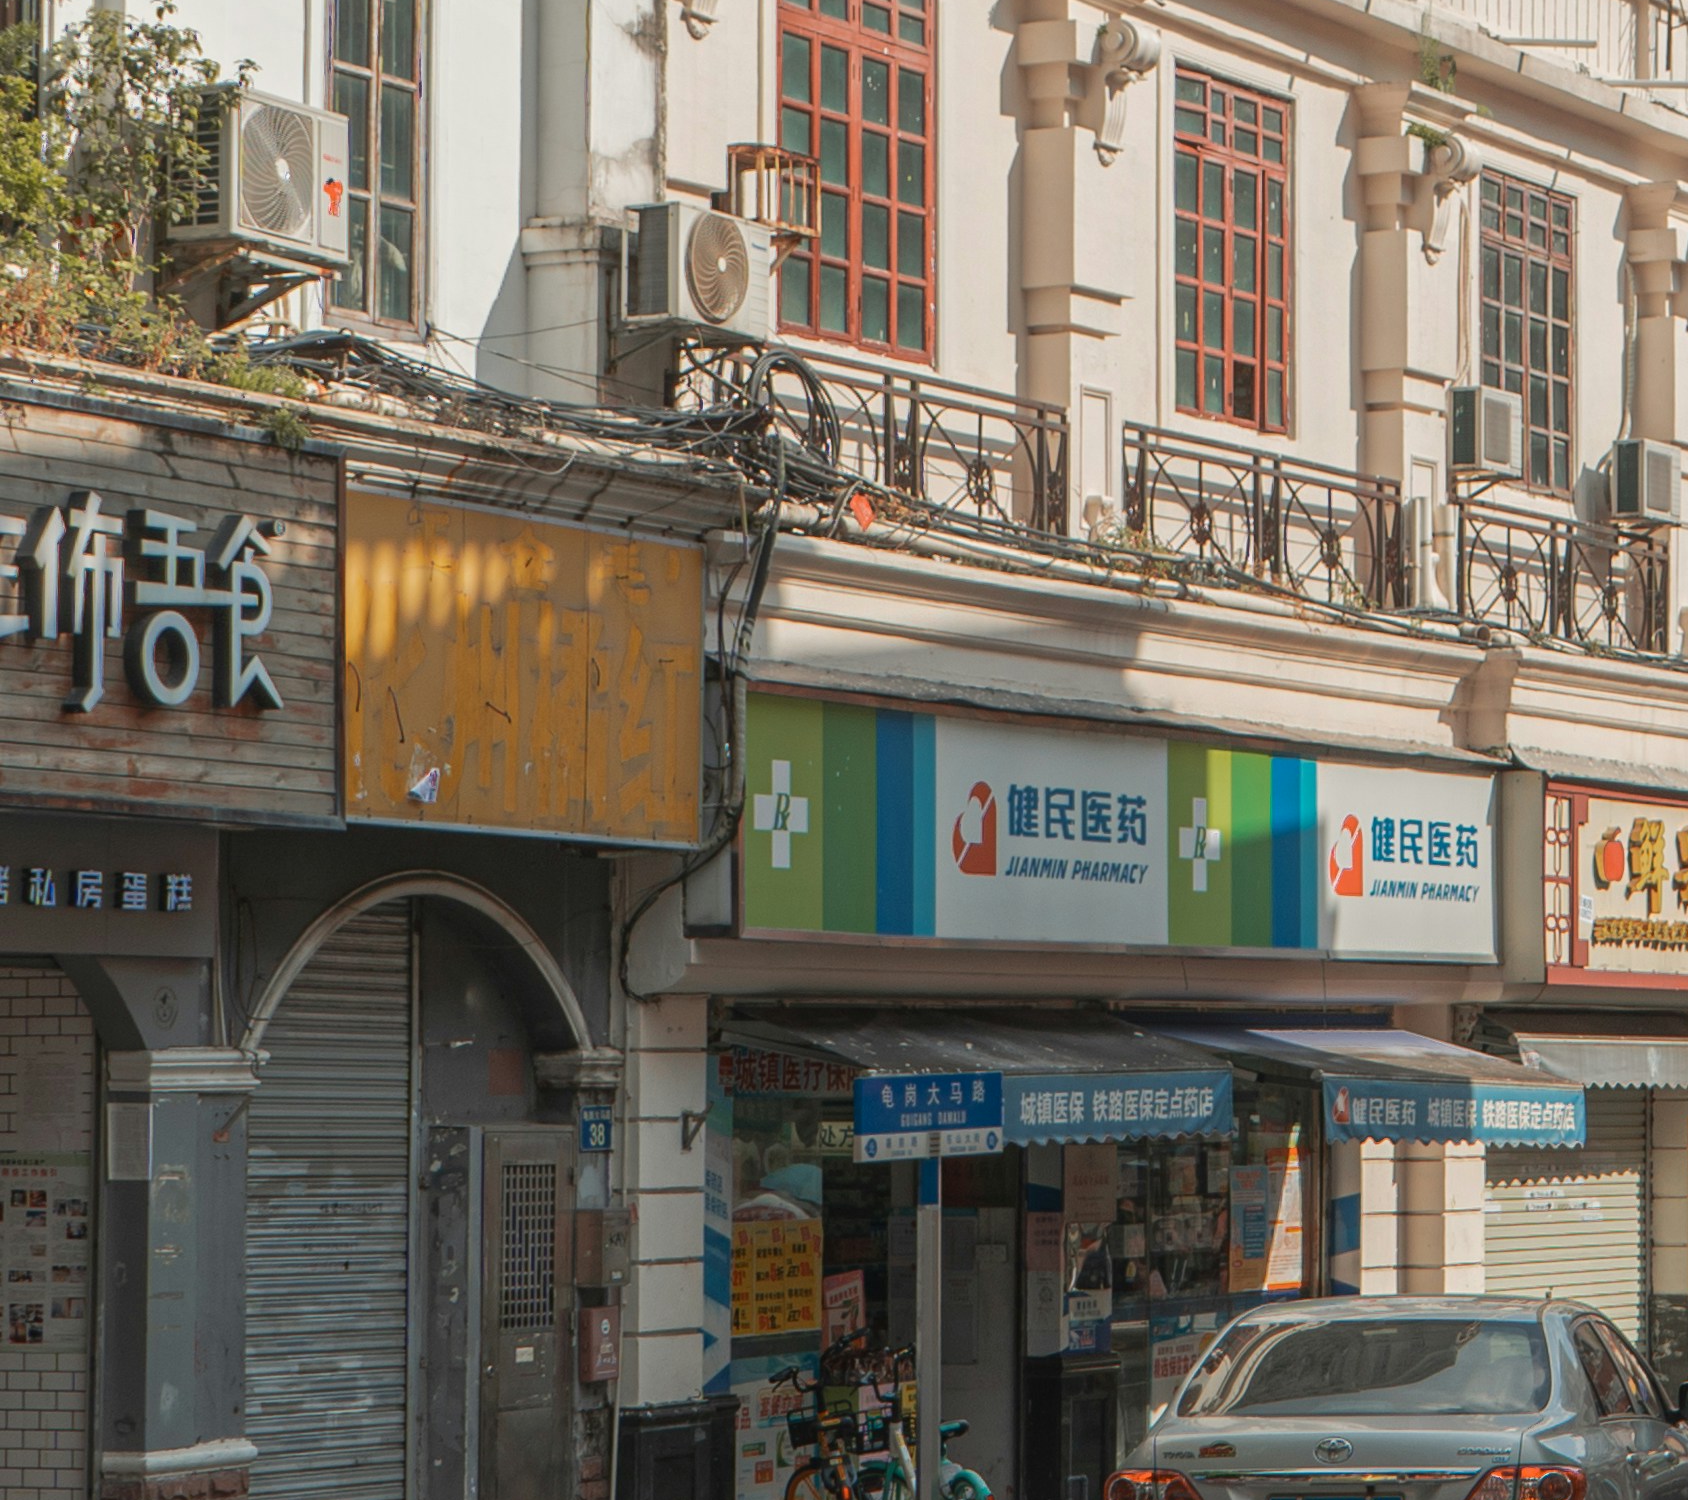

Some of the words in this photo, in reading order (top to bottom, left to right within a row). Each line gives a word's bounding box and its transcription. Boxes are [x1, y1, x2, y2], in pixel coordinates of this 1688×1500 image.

[1007, 784, 1147, 846] 健民医药
[1371, 816, 1478, 868] 健民医药
[1005, 856, 1068, 880] JIANMIN
[1071, 860, 1149, 885] PHARMACY
[1370, 878, 1418, 898] JIANMIN
[1421, 883, 1480, 903] PHARMACY
[881, 1080, 985, 1109] 龟岗大马路
[1020, 1092, 1084, 1125] 城镇医保
[1092, 1087, 1214, 1122] 铁路医保定点药店
[1353, 1099, 1416, 1126] 健民医药
[1427, 1098, 1477, 1127] 城镇医保
[1482, 1100, 1585, 1131] 铁路医保定点药店
[589, 1123, 606, 1146] 38
